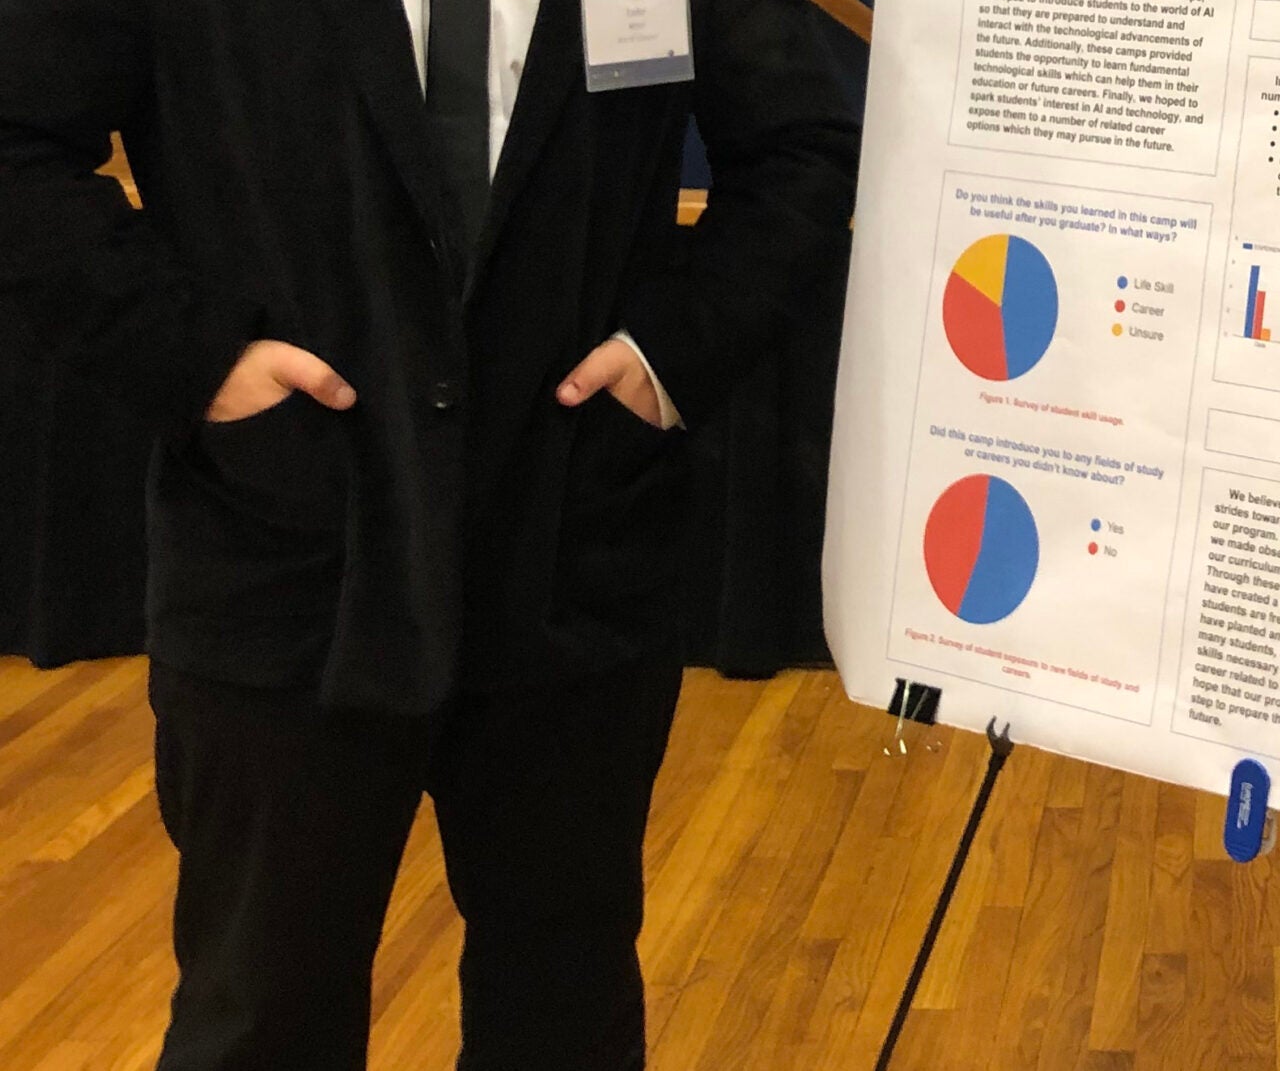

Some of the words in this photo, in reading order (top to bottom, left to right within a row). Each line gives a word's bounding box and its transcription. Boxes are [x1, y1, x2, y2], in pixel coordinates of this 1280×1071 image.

[955, 188, 969, 200] Do
[969, 192, 988, 203] you
[989, 193, 1014, 206] think
[1015, 196, 1032, 208] the
[1033, 199, 1058, 212] skills
[1060, 204, 1078, 215] you
[1080, 204, 1116, 219] learned
[1117, 209, 1127, 221] in
[1129, 211, 1148, 223] this
[1149, 215, 1177, 229] camp
[1179, 218, 1197, 230] will
[1133, 277, 1152, 291] Life
[1153, 280, 1174, 294] Skill
[1131, 301, 1165, 317] Career
[1128, 325, 1164, 342] Unsure
[929, 424, 946, 438] Did
[947, 428, 966, 441] this
[967, 433, 994, 448] camp
[995, 436, 1040, 455] introduce
[1041, 447, 1060, 459] you
[1062, 449, 1073, 461] to
[1073, 453, 1092, 467] any
[1094, 454, 1122, 470] fields
[1123, 461, 1135, 472] of
[1136, 464, 1165, 480] study
[1229, 488, 1246, 502] We
[1107, 520, 1124, 535] Yes
[1103, 544, 1118, 558] No
